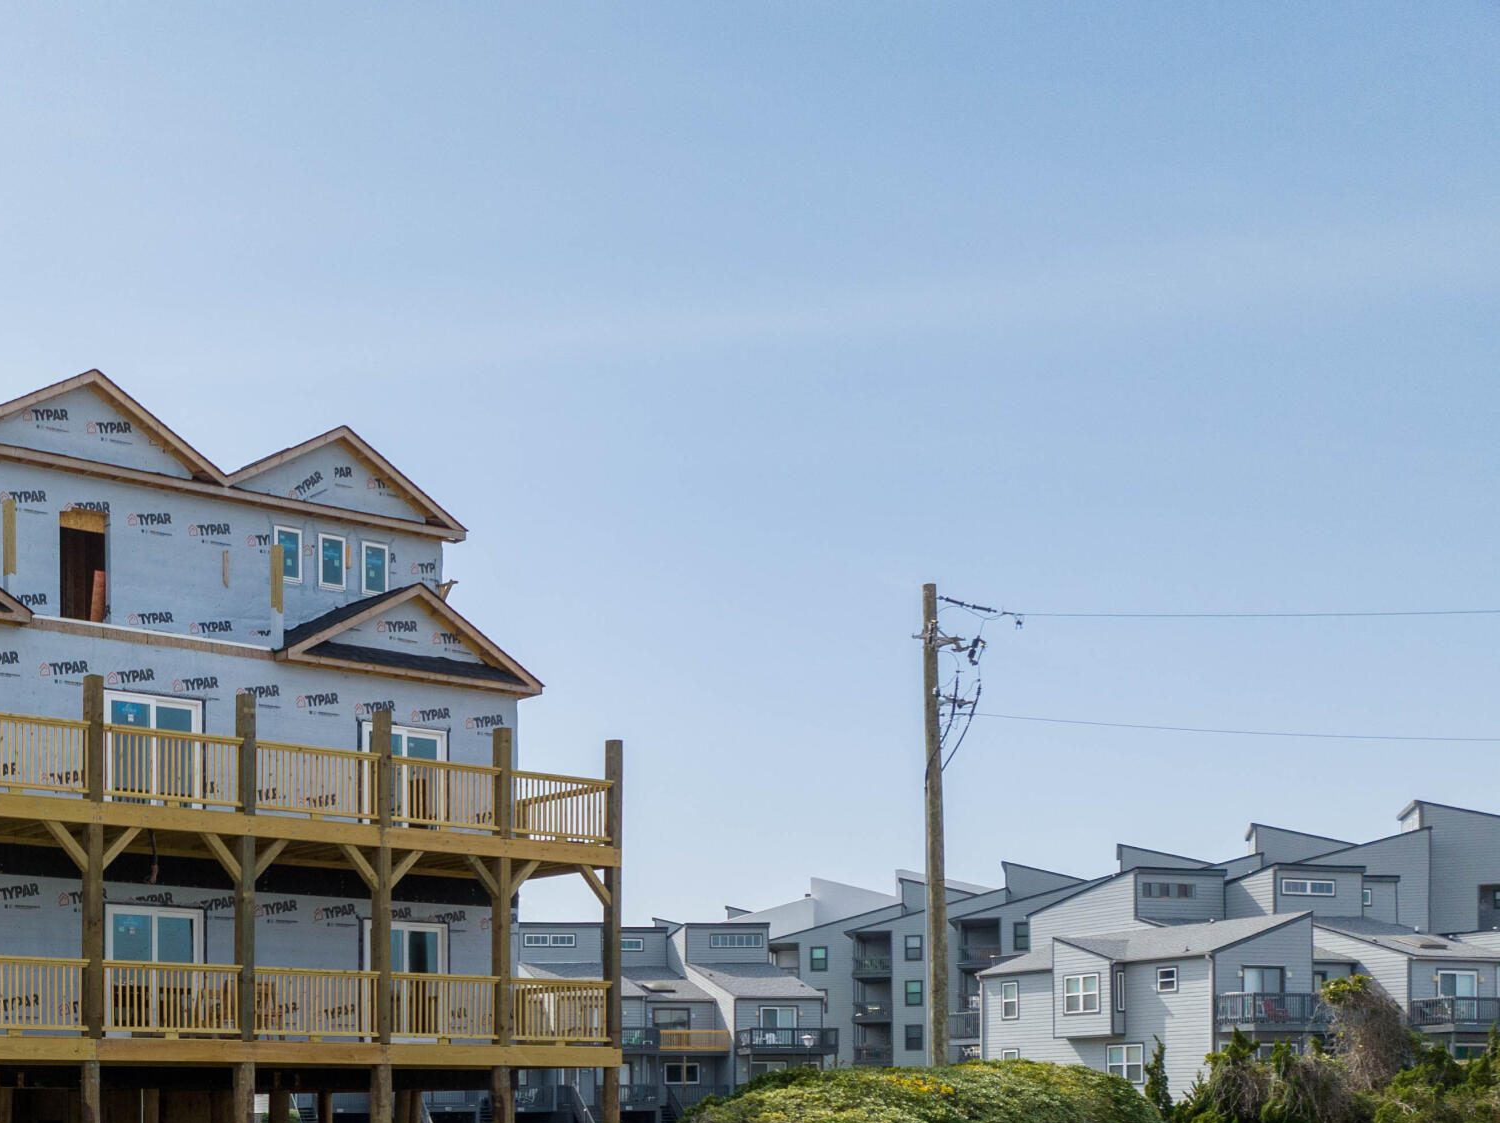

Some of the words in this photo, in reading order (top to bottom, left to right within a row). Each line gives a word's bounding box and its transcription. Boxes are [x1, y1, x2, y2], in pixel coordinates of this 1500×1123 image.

[31, 408, 69, 422] TYPAR
[95, 421, 132, 434] TYPAR
[334, 465, 353, 479] PAR
[294, 470, 324, 496] TYPAR
[10, 490, 48, 504] TYPAR
[137, 512, 172, 526] TYPAR
[197, 523, 231, 536] TYPAR
[418, 562, 436, 575] TYP
[16, 592, 48, 606] YPAR
[138, 611, 174, 625] TYPAR
[198, 620, 233, 634] TYPAR
[385, 620, 418, 633] TYPAR
[49, 660, 89, 676] TYPAR
[117, 668, 155, 684] TYPAR
[182, 676, 220, 692] TYPAR
[245, 684, 280, 698] TYPAR
[305, 692, 339, 707] TYPAR
[419, 707, 451, 722] TYPAR
[473, 714, 504, 729] TYPAR
[0, 882, 40, 901] TYPAR
[263, 899, 298, 916] TYPAR
[323, 903, 356, 920] TYPAR
[391, 906, 412, 919] PAR
